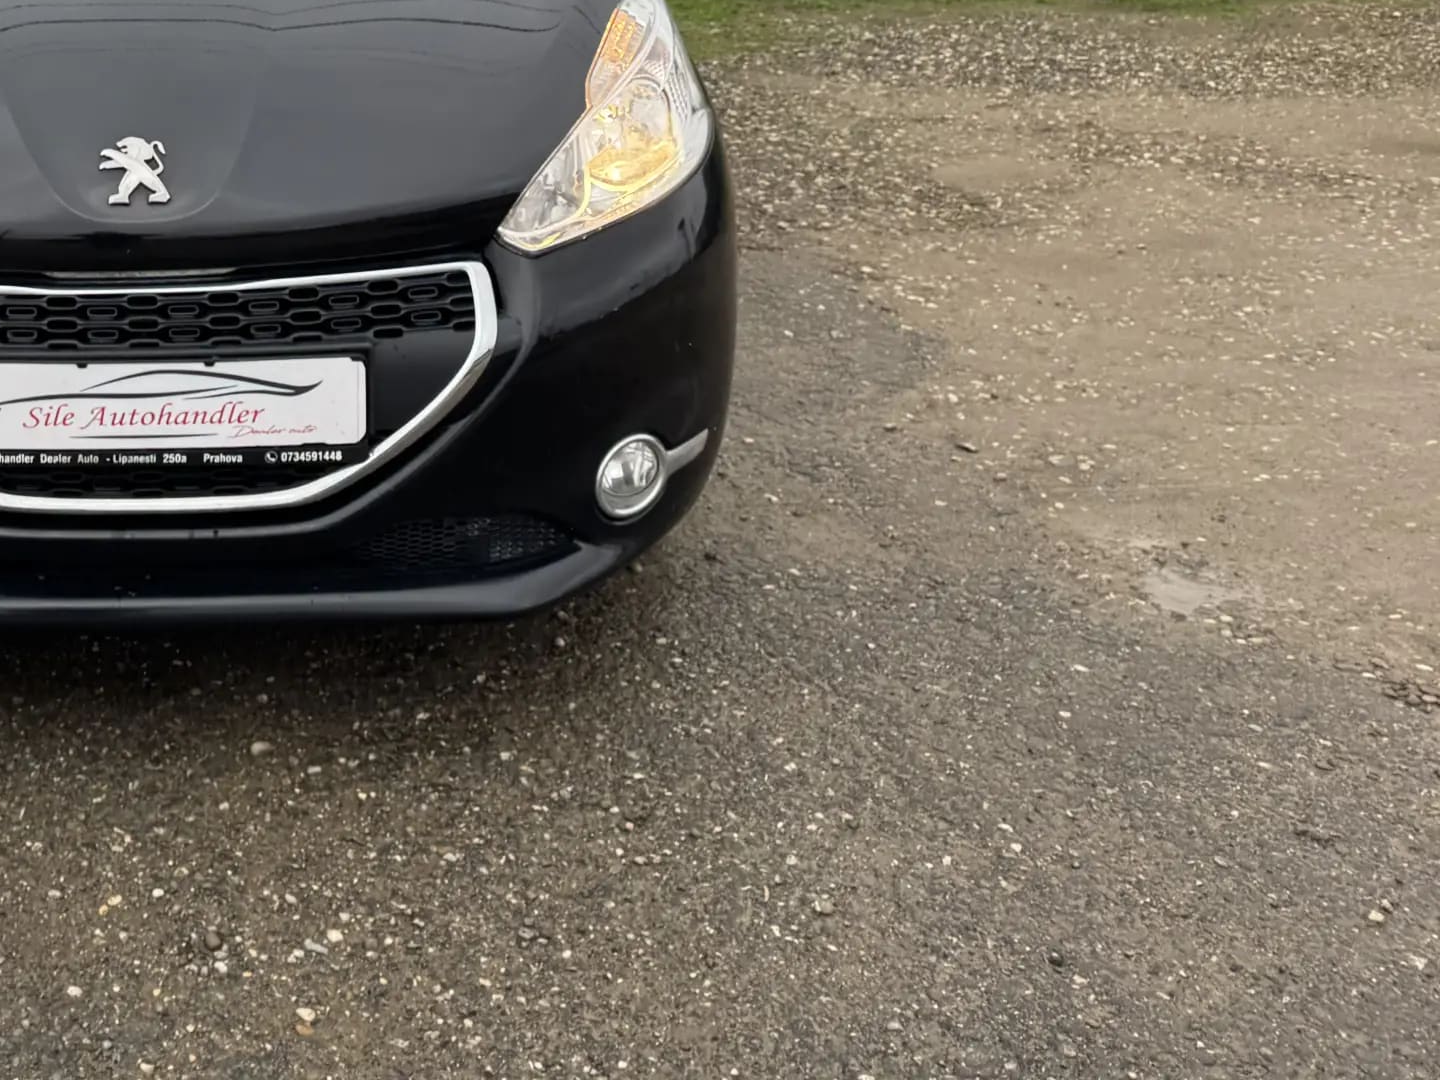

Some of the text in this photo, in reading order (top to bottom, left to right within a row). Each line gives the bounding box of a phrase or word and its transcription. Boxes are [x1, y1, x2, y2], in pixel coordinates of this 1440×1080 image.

[22, 401, 265, 429] Sile Autohandler
[40, 453, 71, 464] Dealer
[77, 453, 99, 464] Auto
[113, 452, 156, 465] Lipanesti
[163, 452, 187, 464] 250a
[203, 452, 243, 464] Prahova
[280, 450, 342, 462] 0734591448
